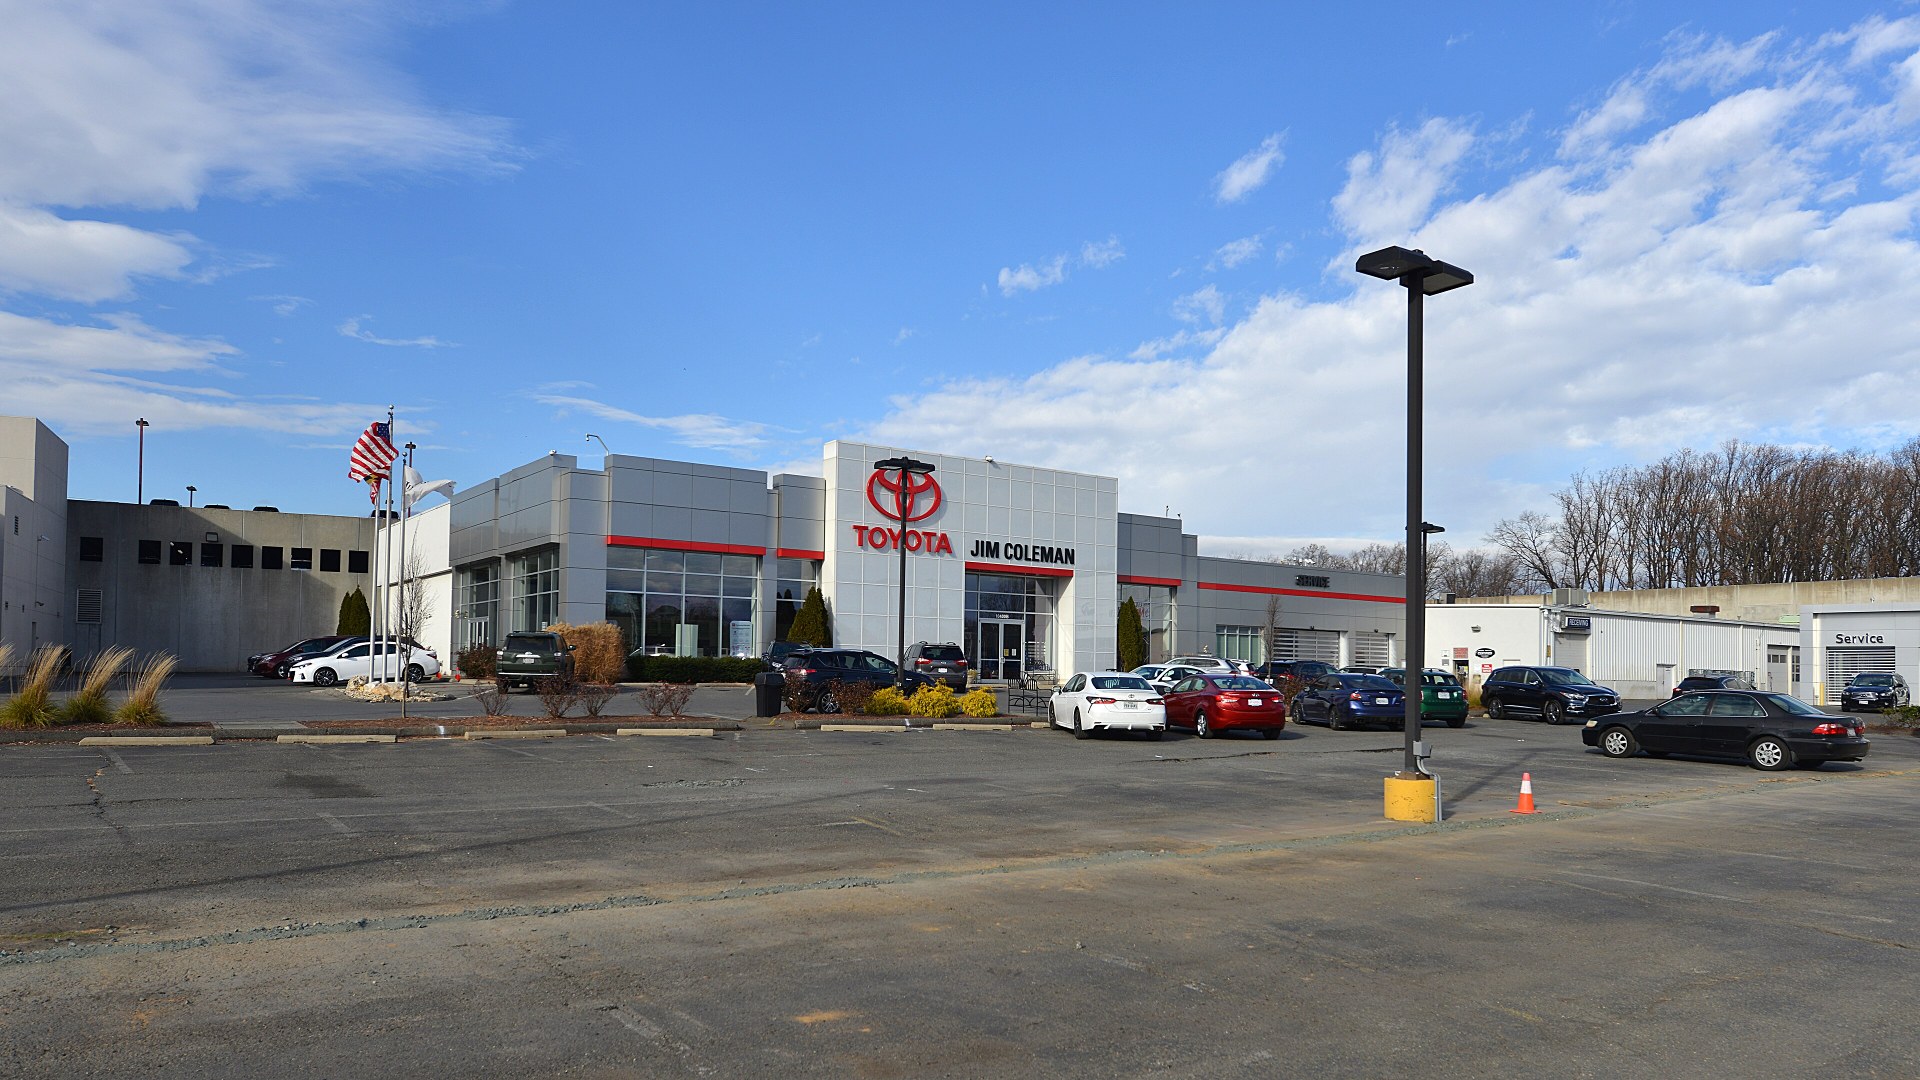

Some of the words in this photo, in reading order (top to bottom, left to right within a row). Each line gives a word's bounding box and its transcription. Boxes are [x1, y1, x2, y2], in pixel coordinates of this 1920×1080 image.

[853, 525, 952, 553] TOYOTA
[970, 540, 1000, 558] JIM
[1004, 543, 1075, 564] COLEMAN
[1295, 575, 1330, 587] SERVICE
[1835, 633, 1884, 644] Service
